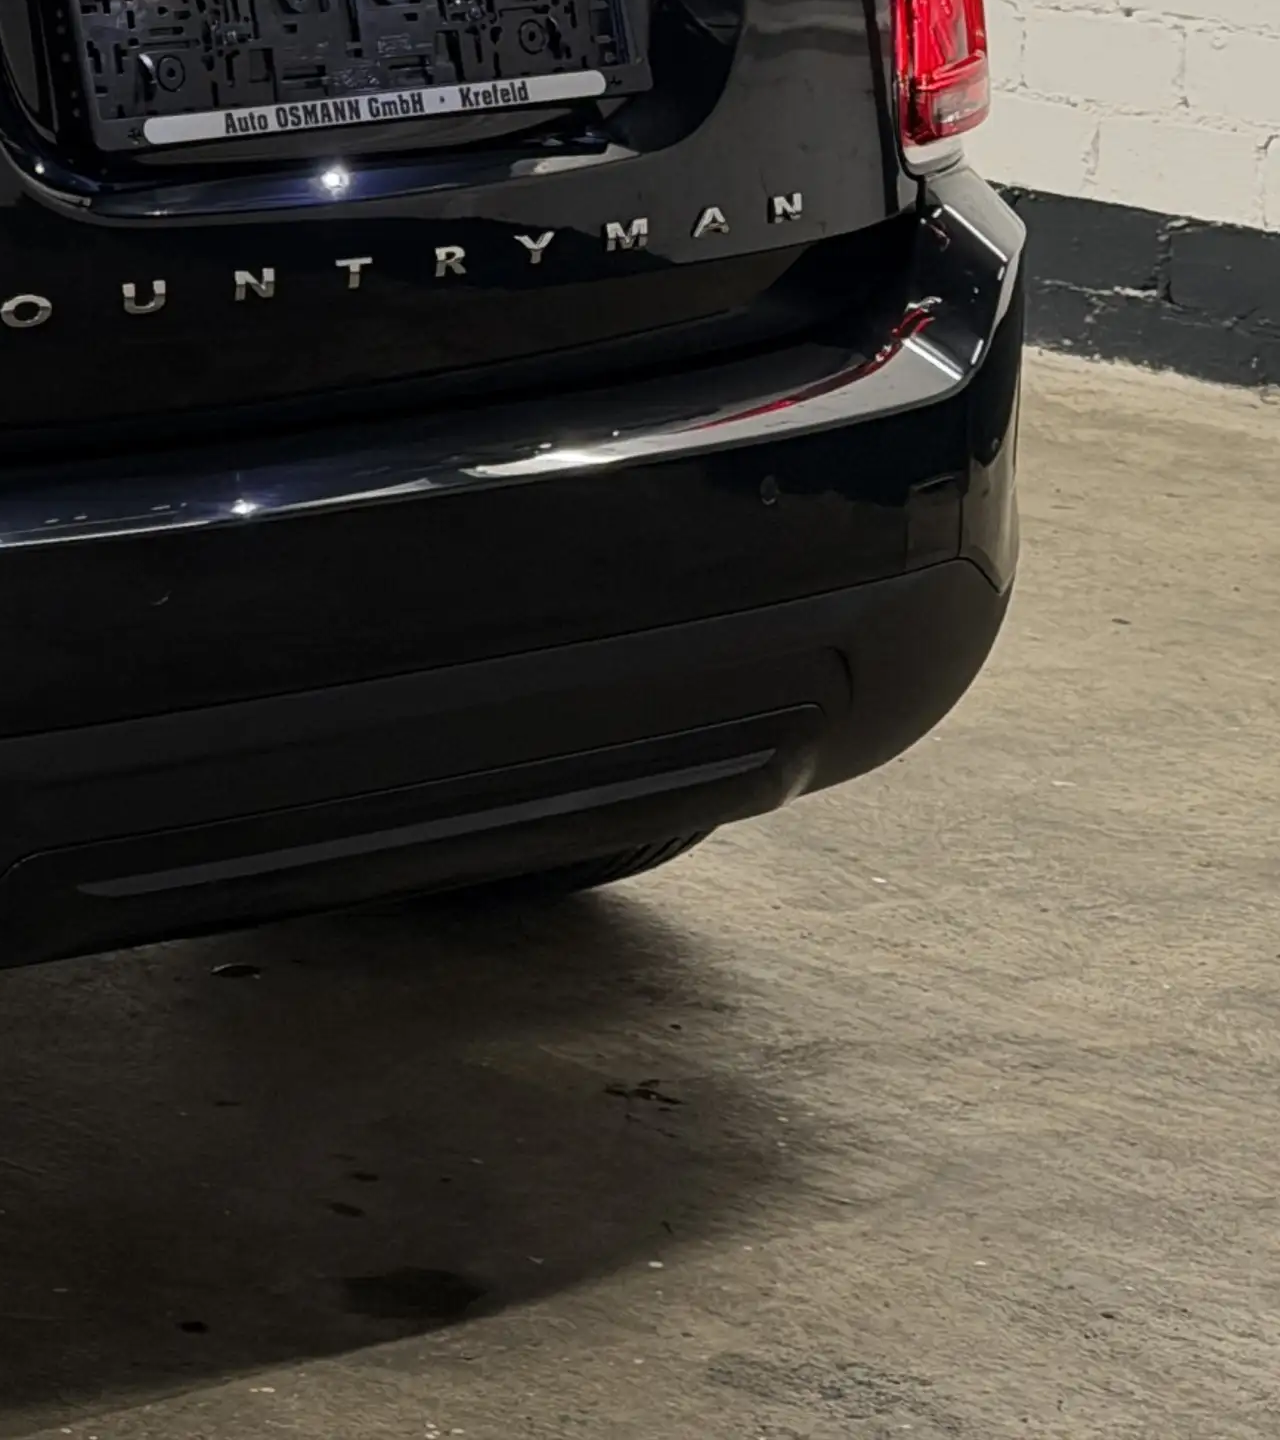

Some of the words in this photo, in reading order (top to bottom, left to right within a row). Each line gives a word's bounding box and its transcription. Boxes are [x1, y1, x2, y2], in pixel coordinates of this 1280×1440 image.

[224, 112, 269, 135] Auto
[276, 99, 362, 129] OSMANN
[367, 91, 426, 120] GmbH
[458, 80, 530, 108] Krefeld
